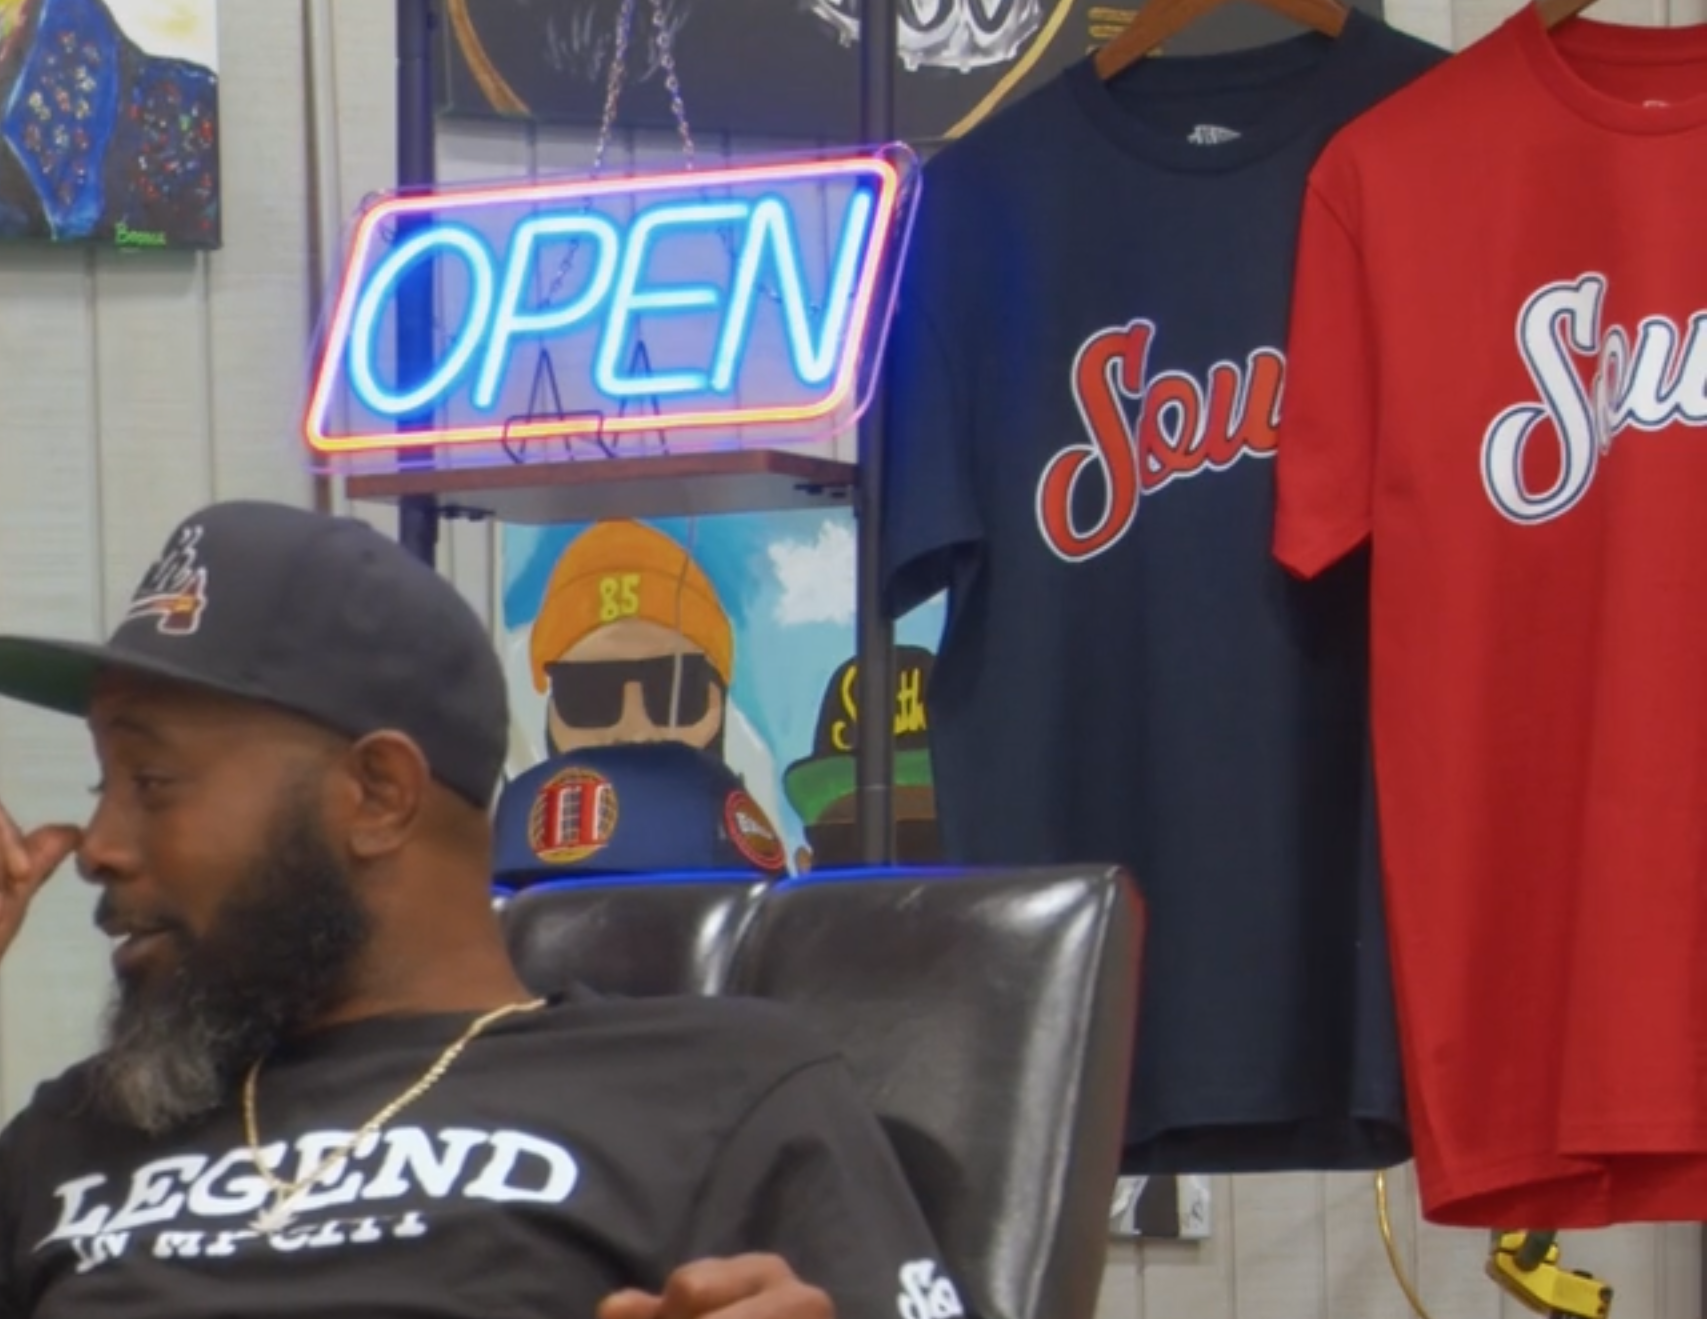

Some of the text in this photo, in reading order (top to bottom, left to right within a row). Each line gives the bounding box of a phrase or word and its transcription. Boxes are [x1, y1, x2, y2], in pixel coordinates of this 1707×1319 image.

[347, 188, 875, 417] OPEN
[599, 571, 642, 622] 85
[31, 1126, 579, 1254] LEGEND
